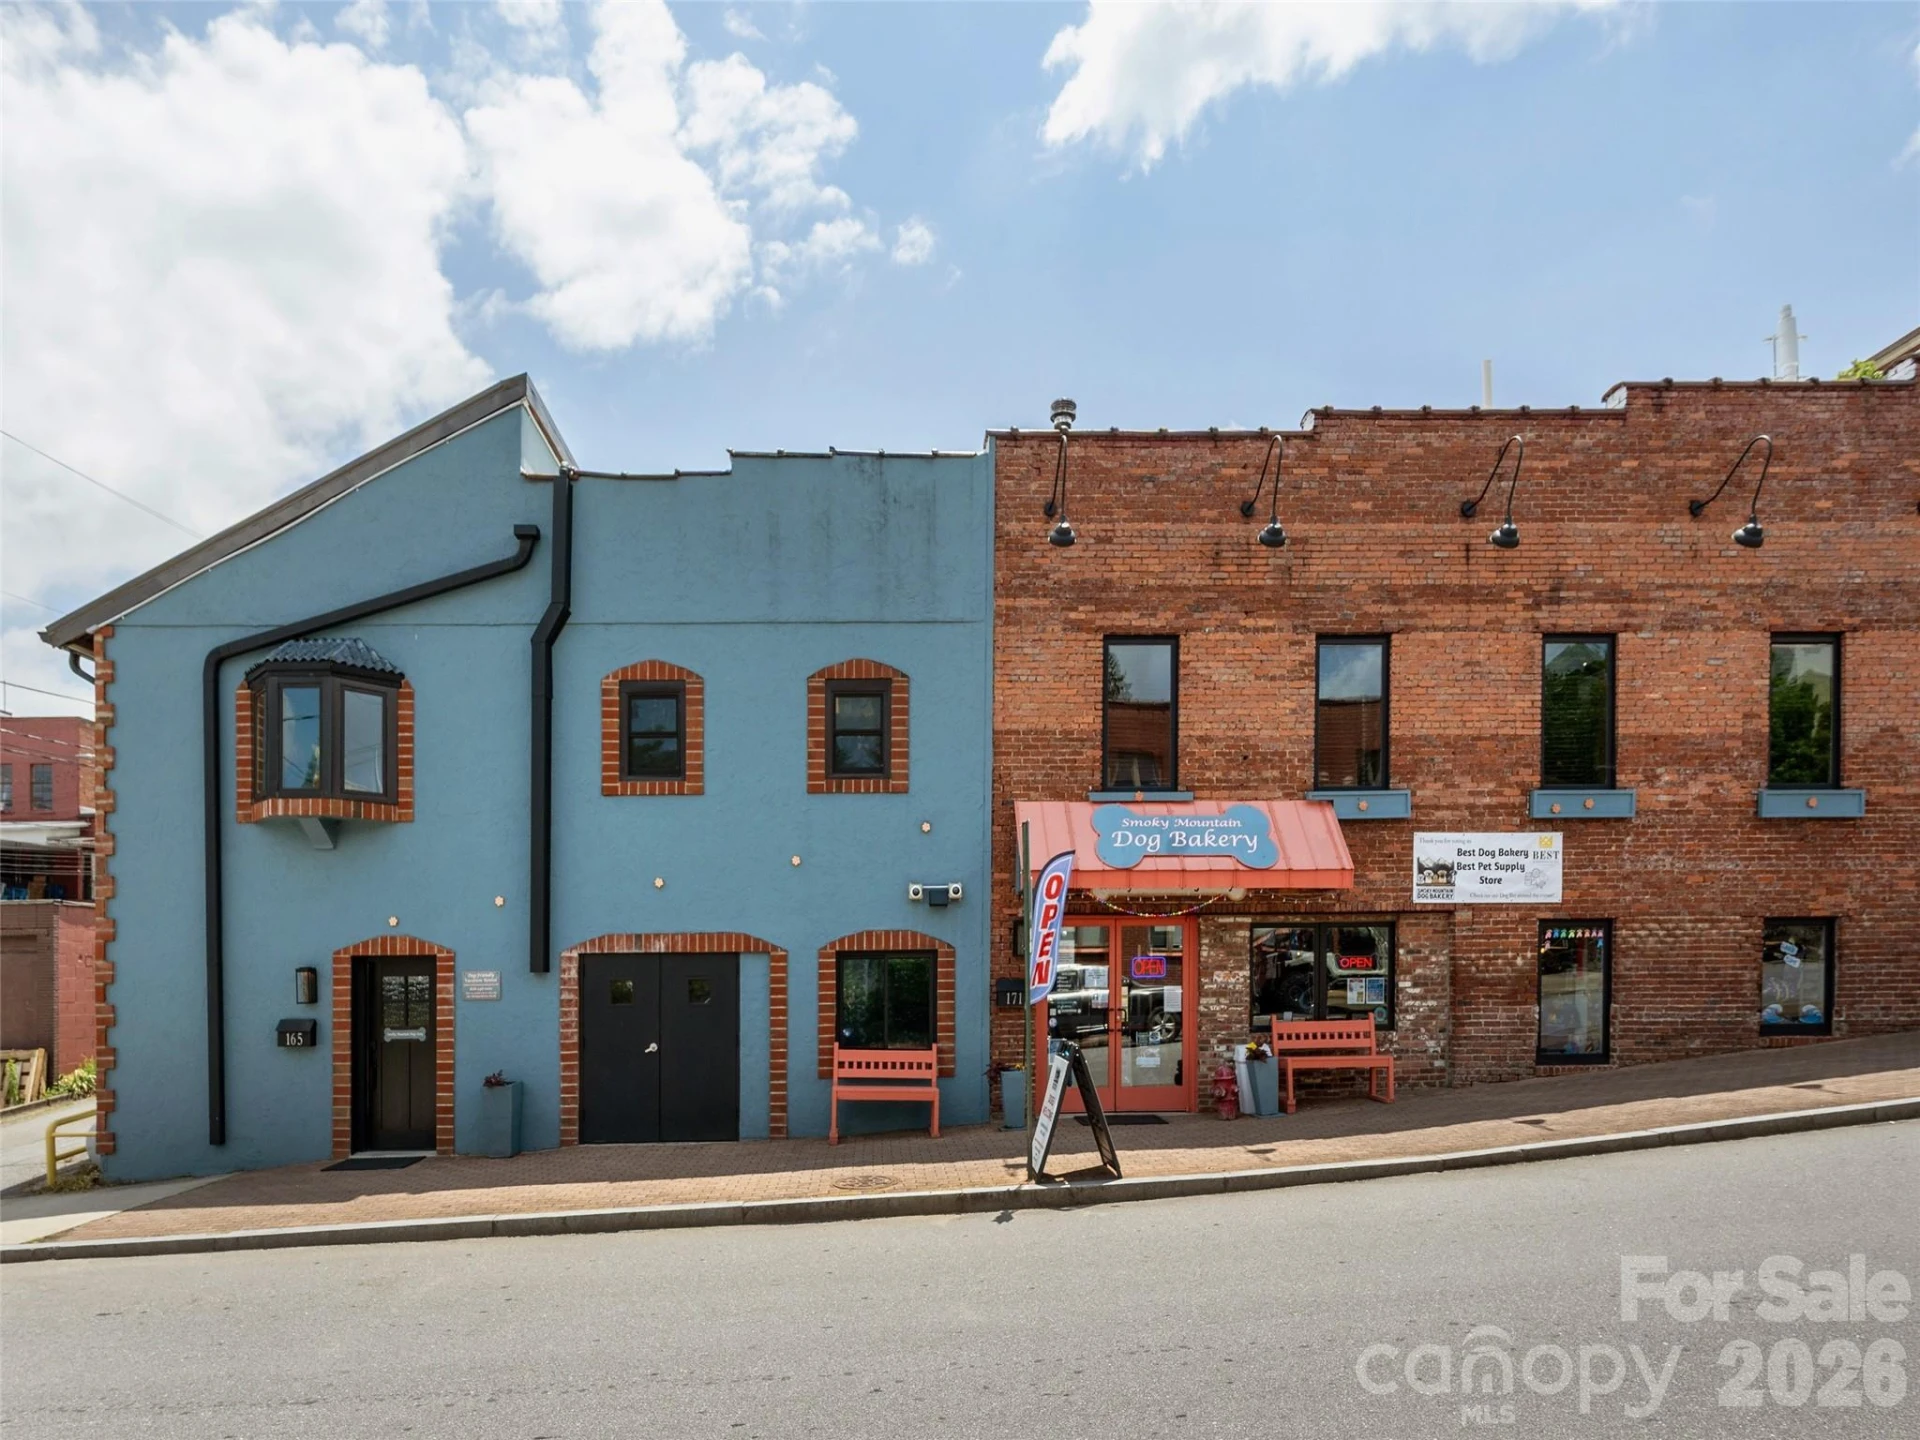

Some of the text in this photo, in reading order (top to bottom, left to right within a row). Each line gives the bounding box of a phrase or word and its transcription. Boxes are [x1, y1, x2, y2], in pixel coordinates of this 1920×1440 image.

[1121, 817, 1242, 829] Smoky Mountain
[1111, 830, 1258, 853] Dog Bakery
[1457, 848, 1529, 859] Best Dog Bakery
[1532, 850, 1559, 860] BEST
[1456, 862, 1475, 871] Best
[1478, 862, 1492, 871] Pet
[1494, 862, 1525, 873] Supply
[1479, 876, 1502, 885] Store
[1030, 872, 1064, 989] OPEN
[1134, 959, 1164, 975] OPEN
[1339, 957, 1373, 968] OPEN
[1006, 992, 1022, 1005] 171
[285, 1032, 303, 1046] 165
